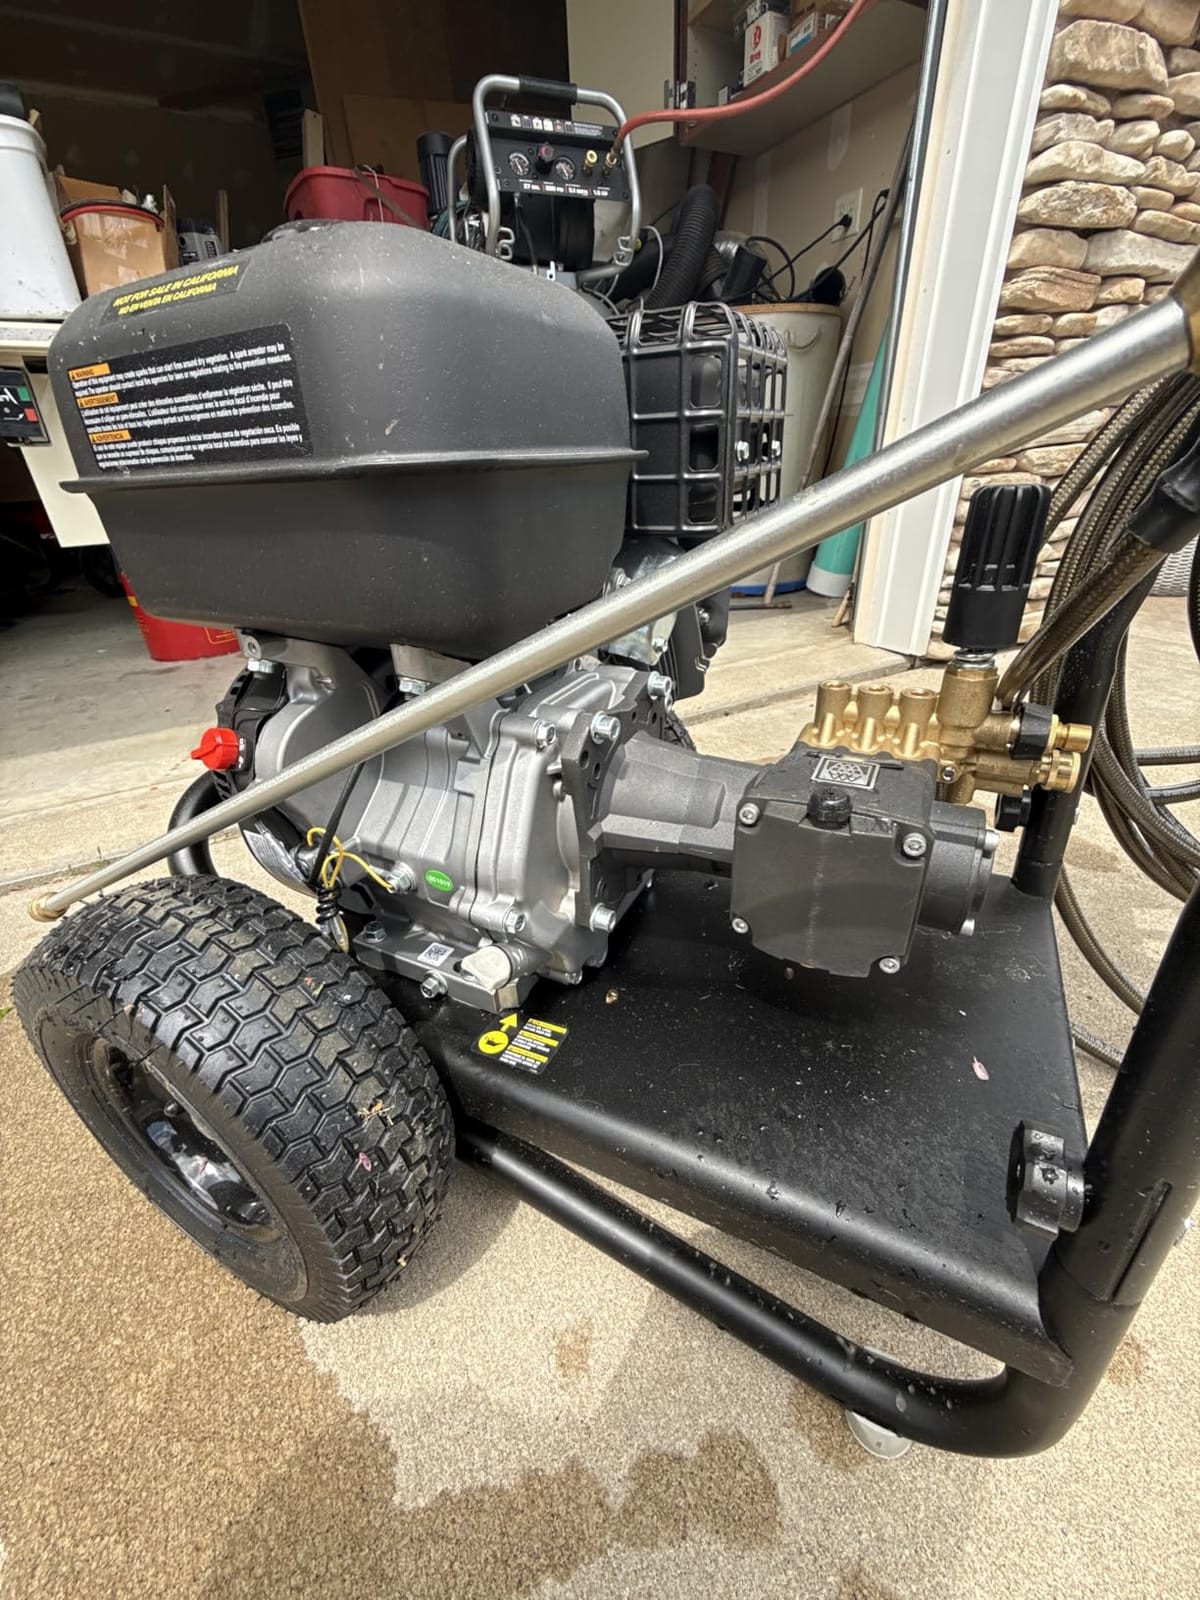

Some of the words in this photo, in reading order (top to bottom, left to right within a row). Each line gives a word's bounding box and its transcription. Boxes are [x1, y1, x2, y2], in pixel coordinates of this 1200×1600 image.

[113, 295, 132, 307] NOT
[131, 291, 150, 302] FOR
[149, 284, 172, 297] SALE
[171, 280, 184, 291] IN
[184, 265, 239, 287] CALIFORNIA
[118, 305, 129, 315] NO
[140, 297, 161, 309] VENTA
[161, 294, 173, 304] EN
[173, 282, 217, 301] CALIFORNIA
